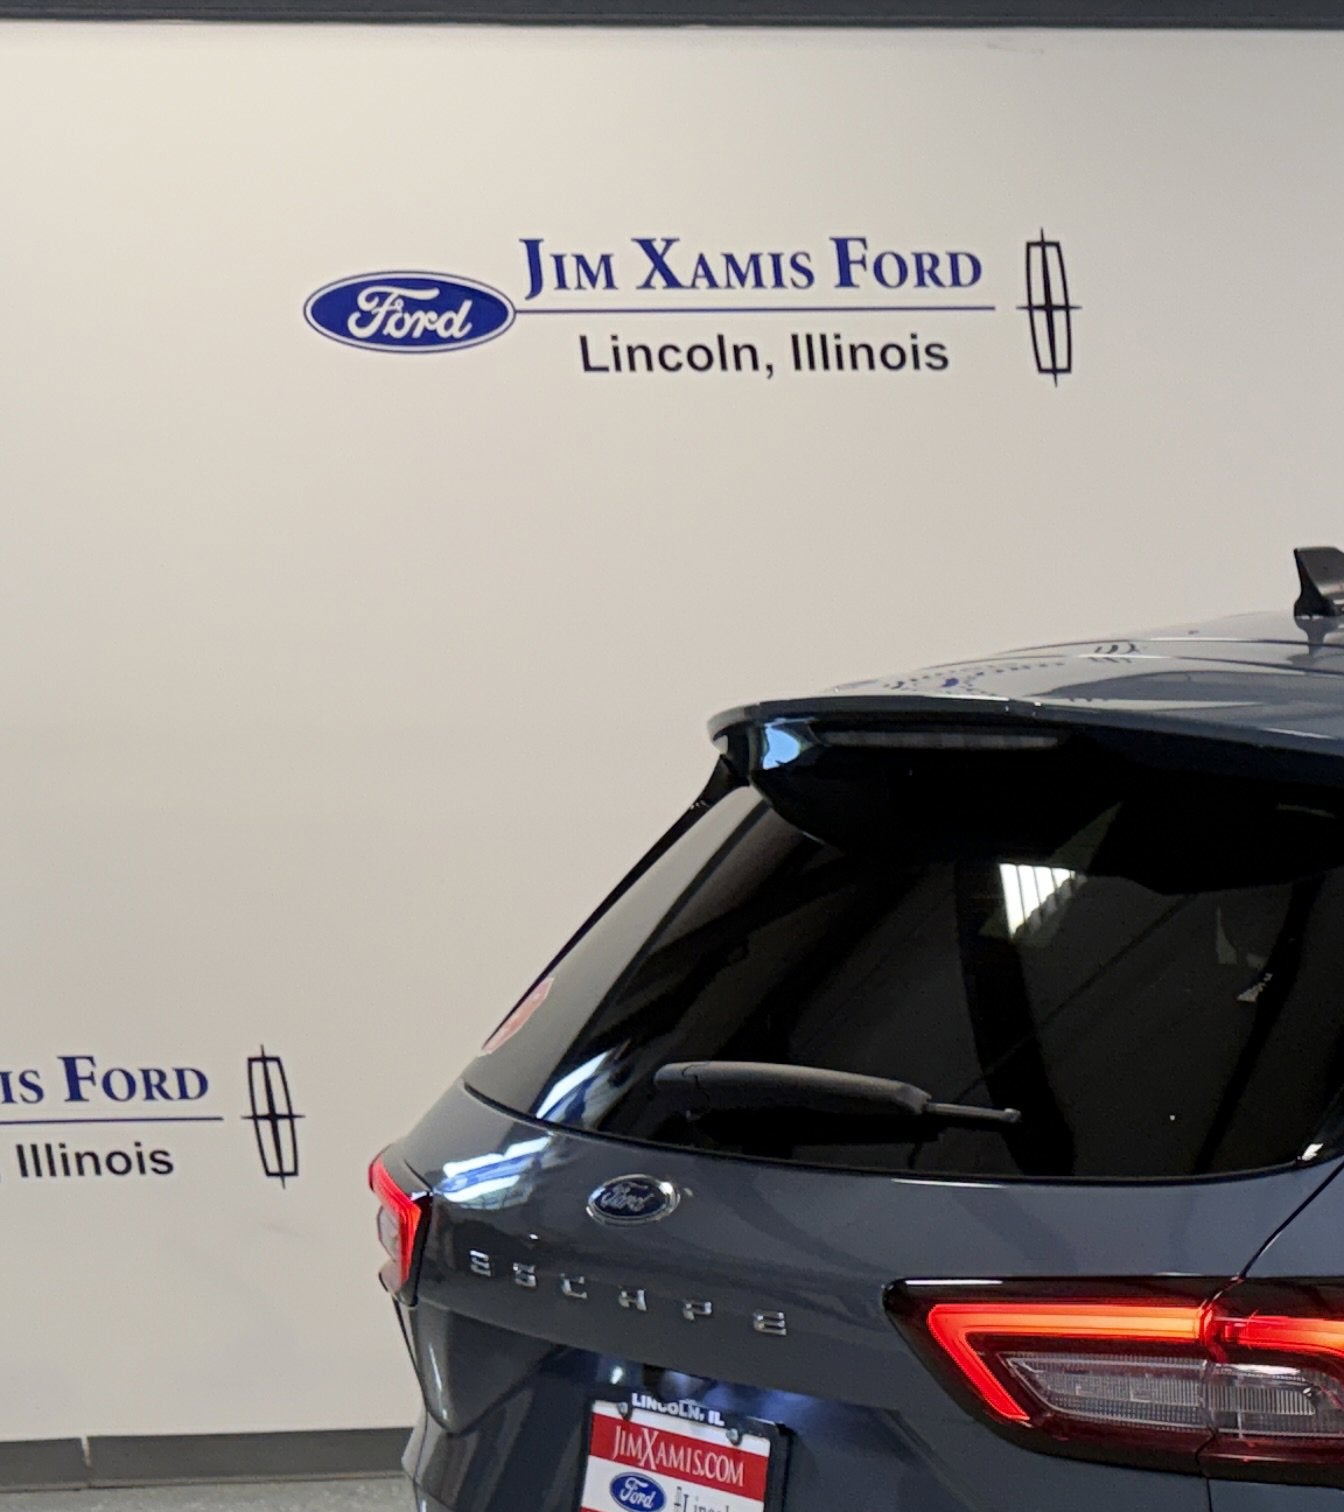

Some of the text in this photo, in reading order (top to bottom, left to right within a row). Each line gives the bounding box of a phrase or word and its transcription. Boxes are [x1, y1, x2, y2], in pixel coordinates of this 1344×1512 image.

[518, 236, 983, 301] JIM XAMIS FORD
[347, 285, 473, 339] Ford
[579, 332, 950, 380] Lincoln, Illinois
[56, 1055, 209, 1103] FORD
[15, 1141, 175, 1178] Illinois
[469, 1249, 788, 1336] ESCAPE
[631, 1392, 725, 1426] LINCOLN, IL
[611, 1424, 744, 1488] JIMXAMIS.COM
[619, 1476, 655, 1509] Ford
